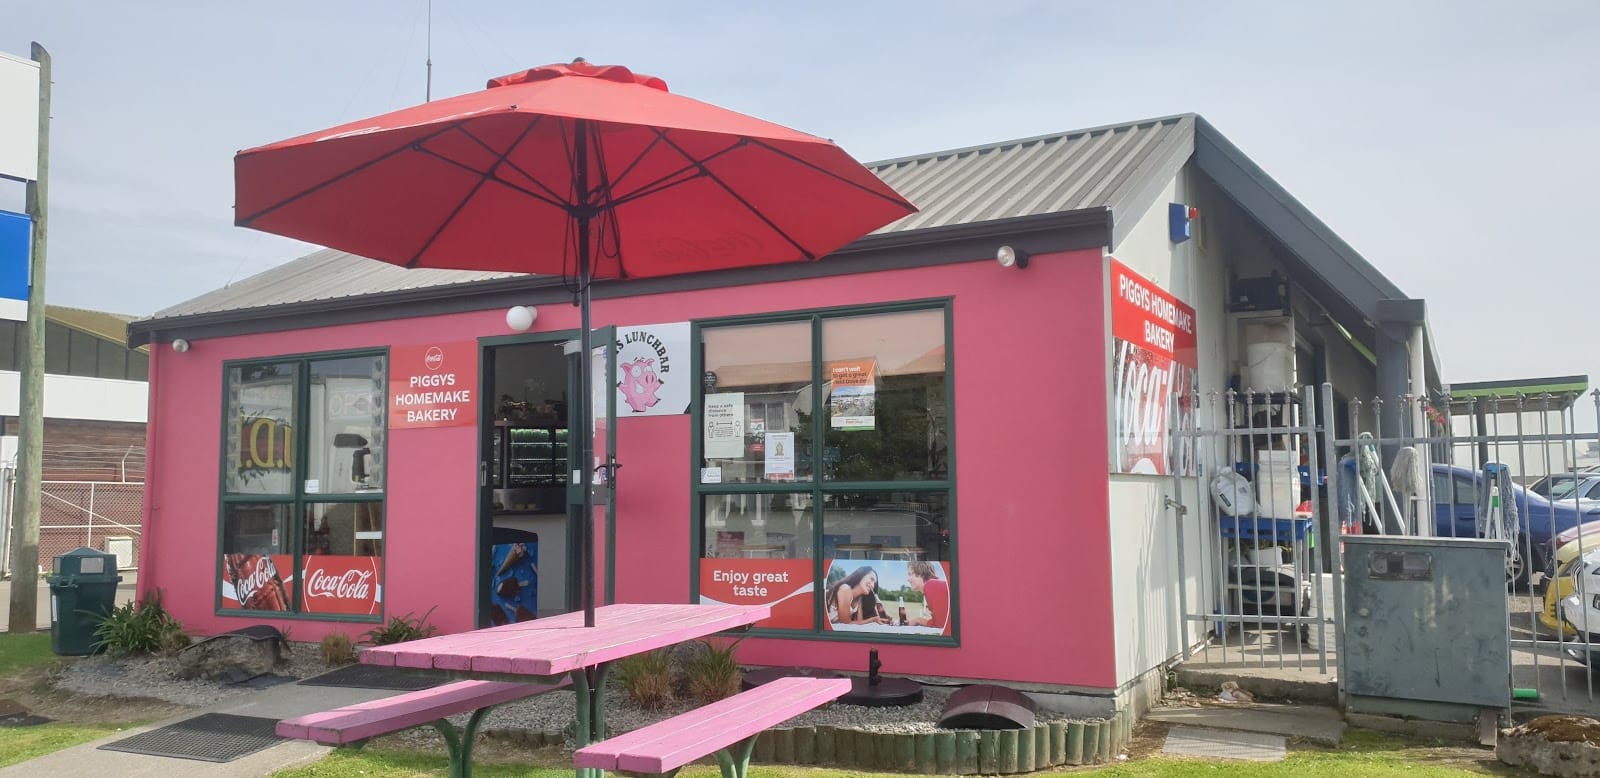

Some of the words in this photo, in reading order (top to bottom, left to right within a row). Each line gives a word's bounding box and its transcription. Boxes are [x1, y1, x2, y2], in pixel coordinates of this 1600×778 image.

[1119, 273, 1151, 311] PIGGYS
[1151, 293, 1192, 335] HOMEMAKE
[1145, 319, 1174, 353] BAKERY
[625, 331, 670, 373] LUNCHBAR
[410, 373, 455, 388] PIGGYS
[395, 390, 470, 406] HOMEMAKE
[407, 408, 457, 422] BAKERY
[237, 557, 276, 605] Coca-Cola
[308, 568, 374, 600] Coca-Cola
[713, 570, 749, 585] Enjoy
[753, 570, 789, 585] great
[733, 585, 768, 597] taste
